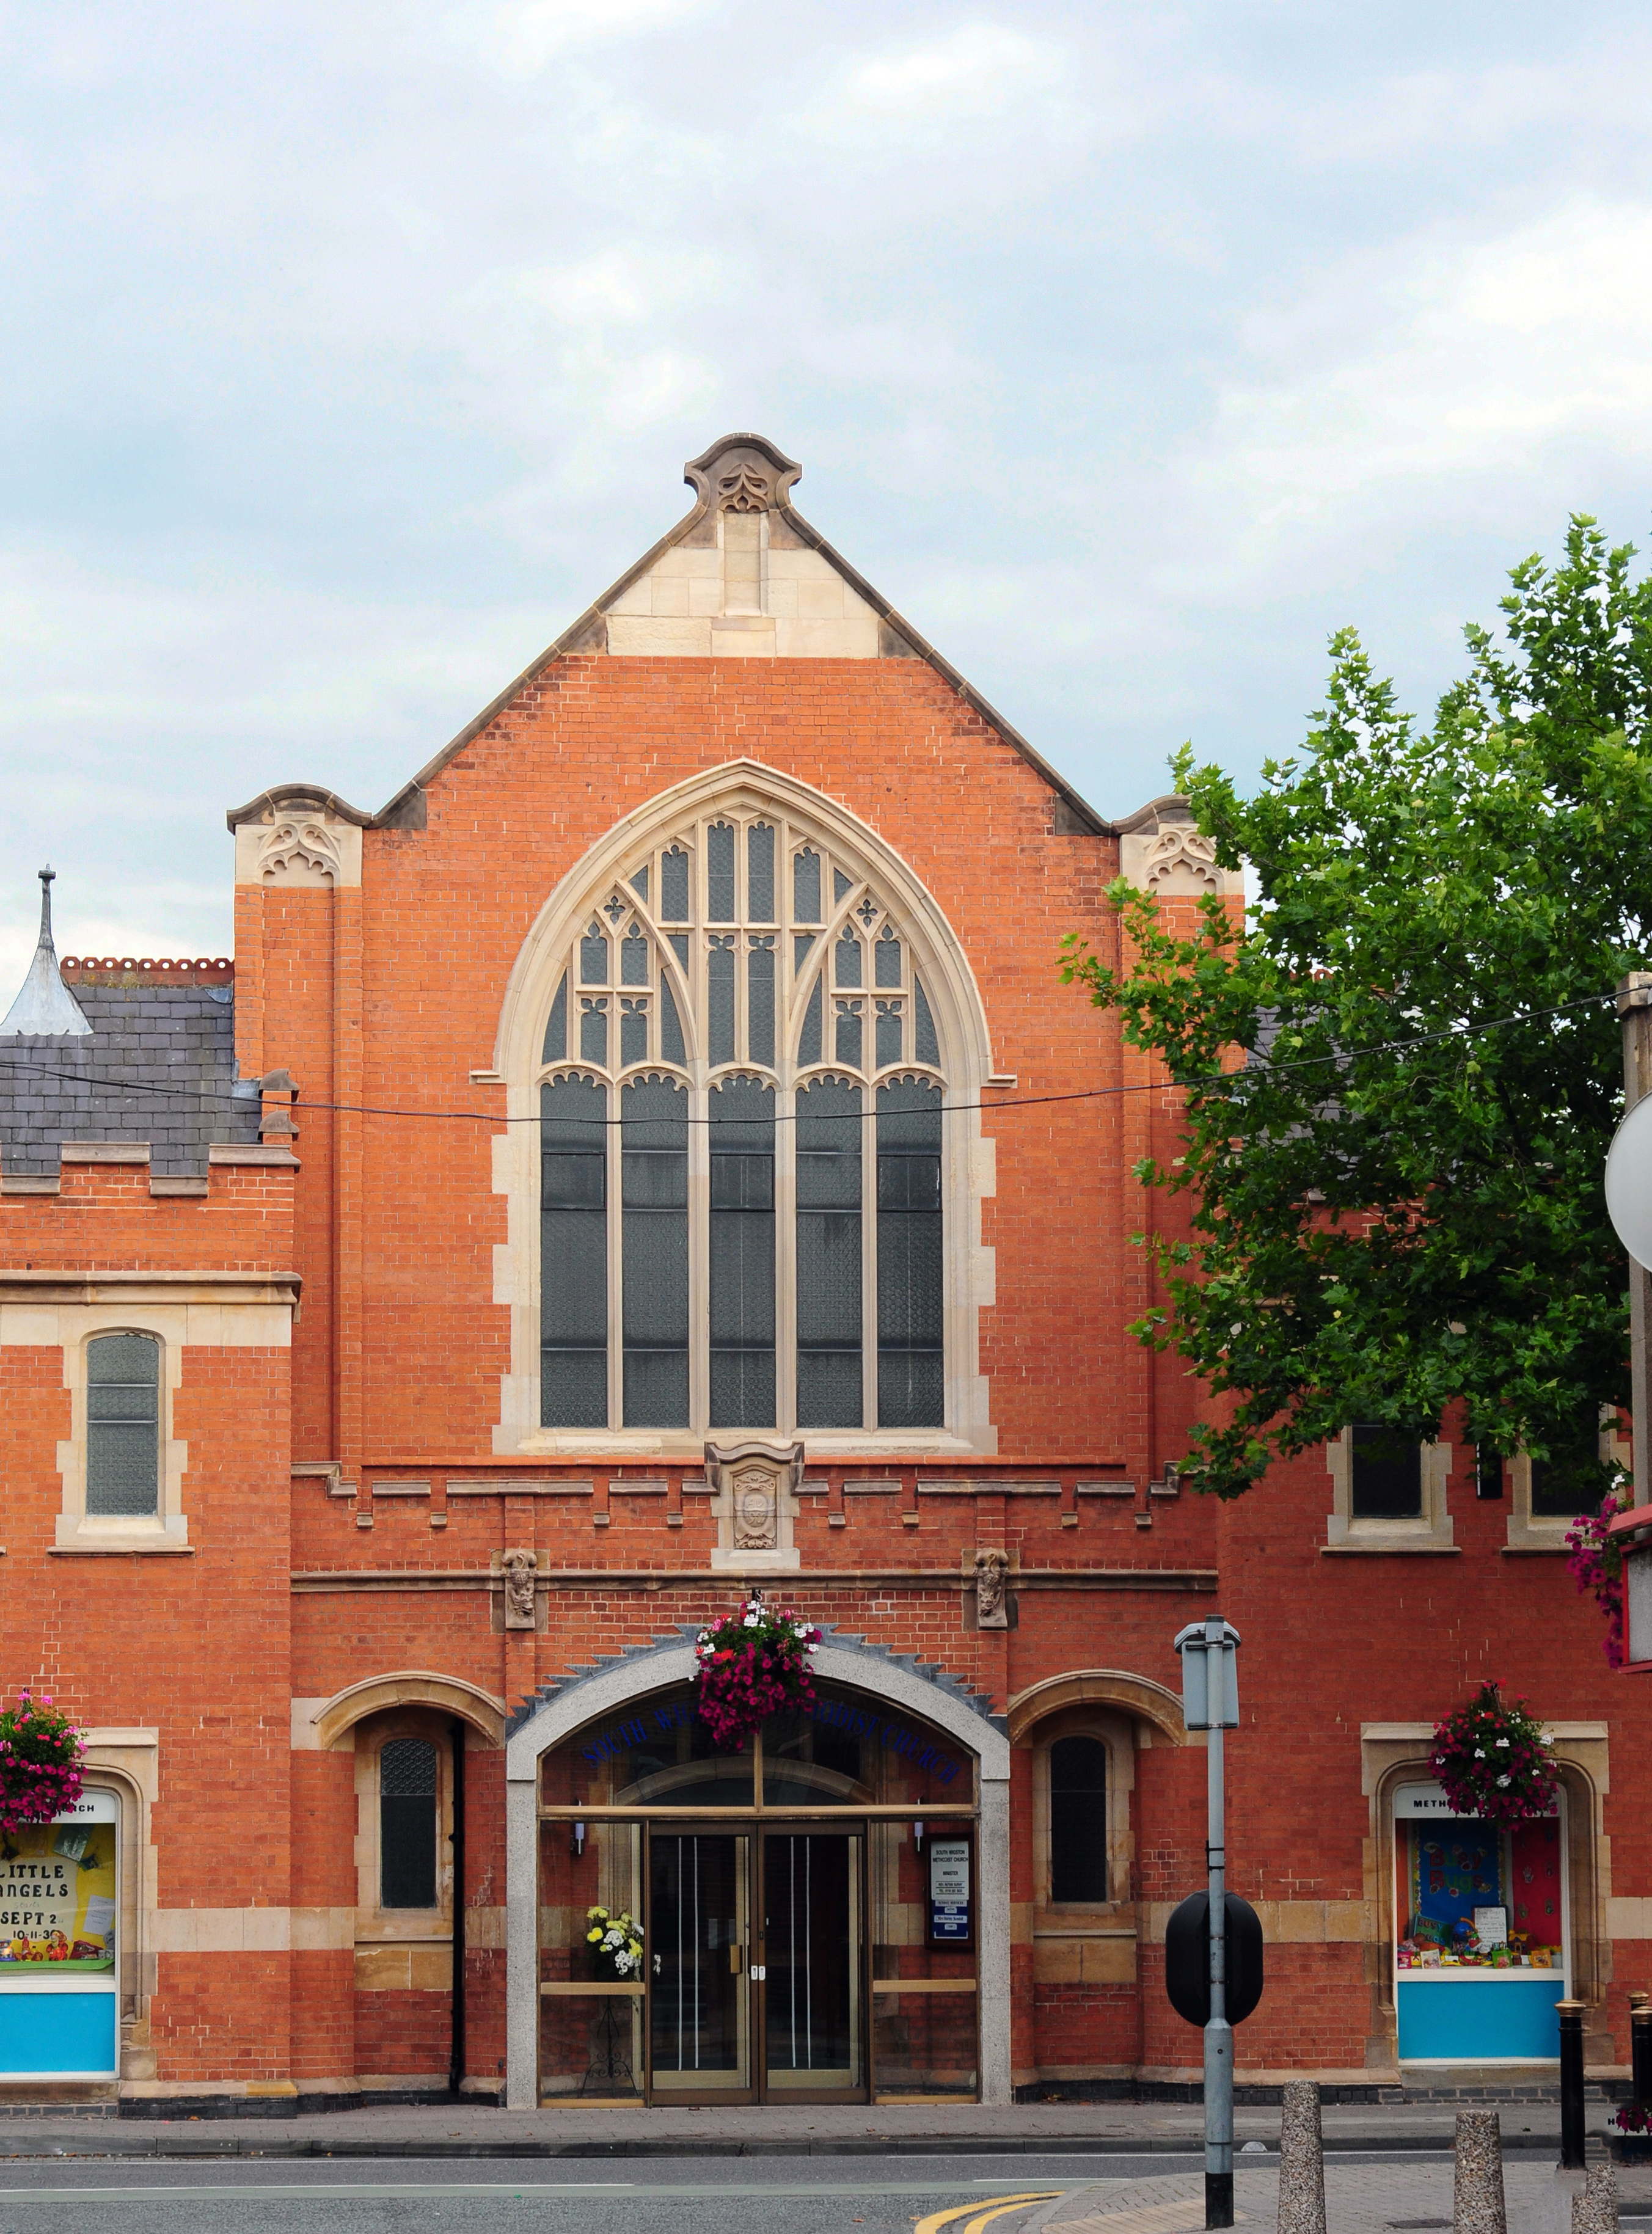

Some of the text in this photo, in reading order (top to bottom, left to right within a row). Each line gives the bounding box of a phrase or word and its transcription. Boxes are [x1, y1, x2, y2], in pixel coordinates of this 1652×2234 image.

[582, 1718, 648, 1768] SOUTH
[653, 1701, 700, 1732] WIG
[882, 1724, 961, 1784] CHURCH
[1, 1911, 44, 1925] SEPT
